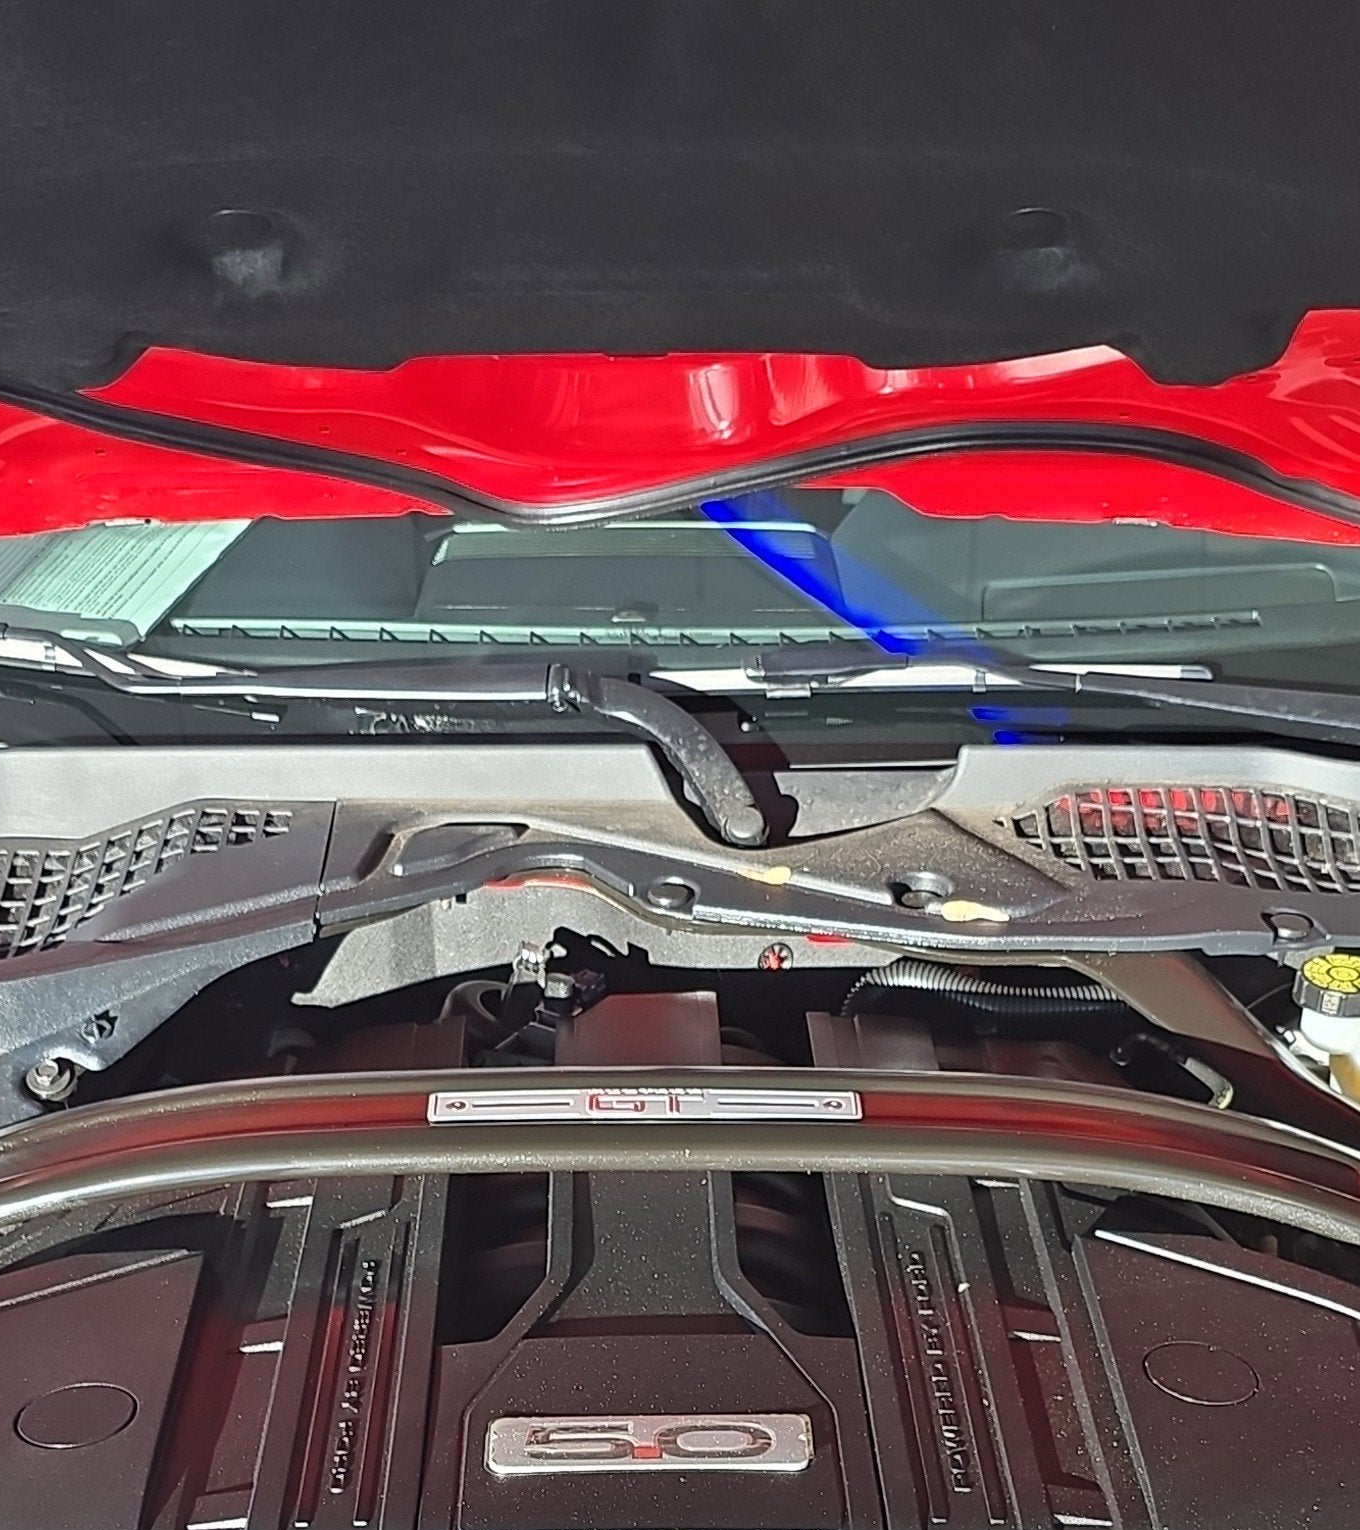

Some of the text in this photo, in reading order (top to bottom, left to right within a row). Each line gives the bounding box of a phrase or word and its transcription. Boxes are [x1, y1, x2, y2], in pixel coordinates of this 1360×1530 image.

[921, 1324, 944, 1356] BY
[524, 1421, 776, 1460] 5.0
[931, 1363, 972, 1493] POWERED
